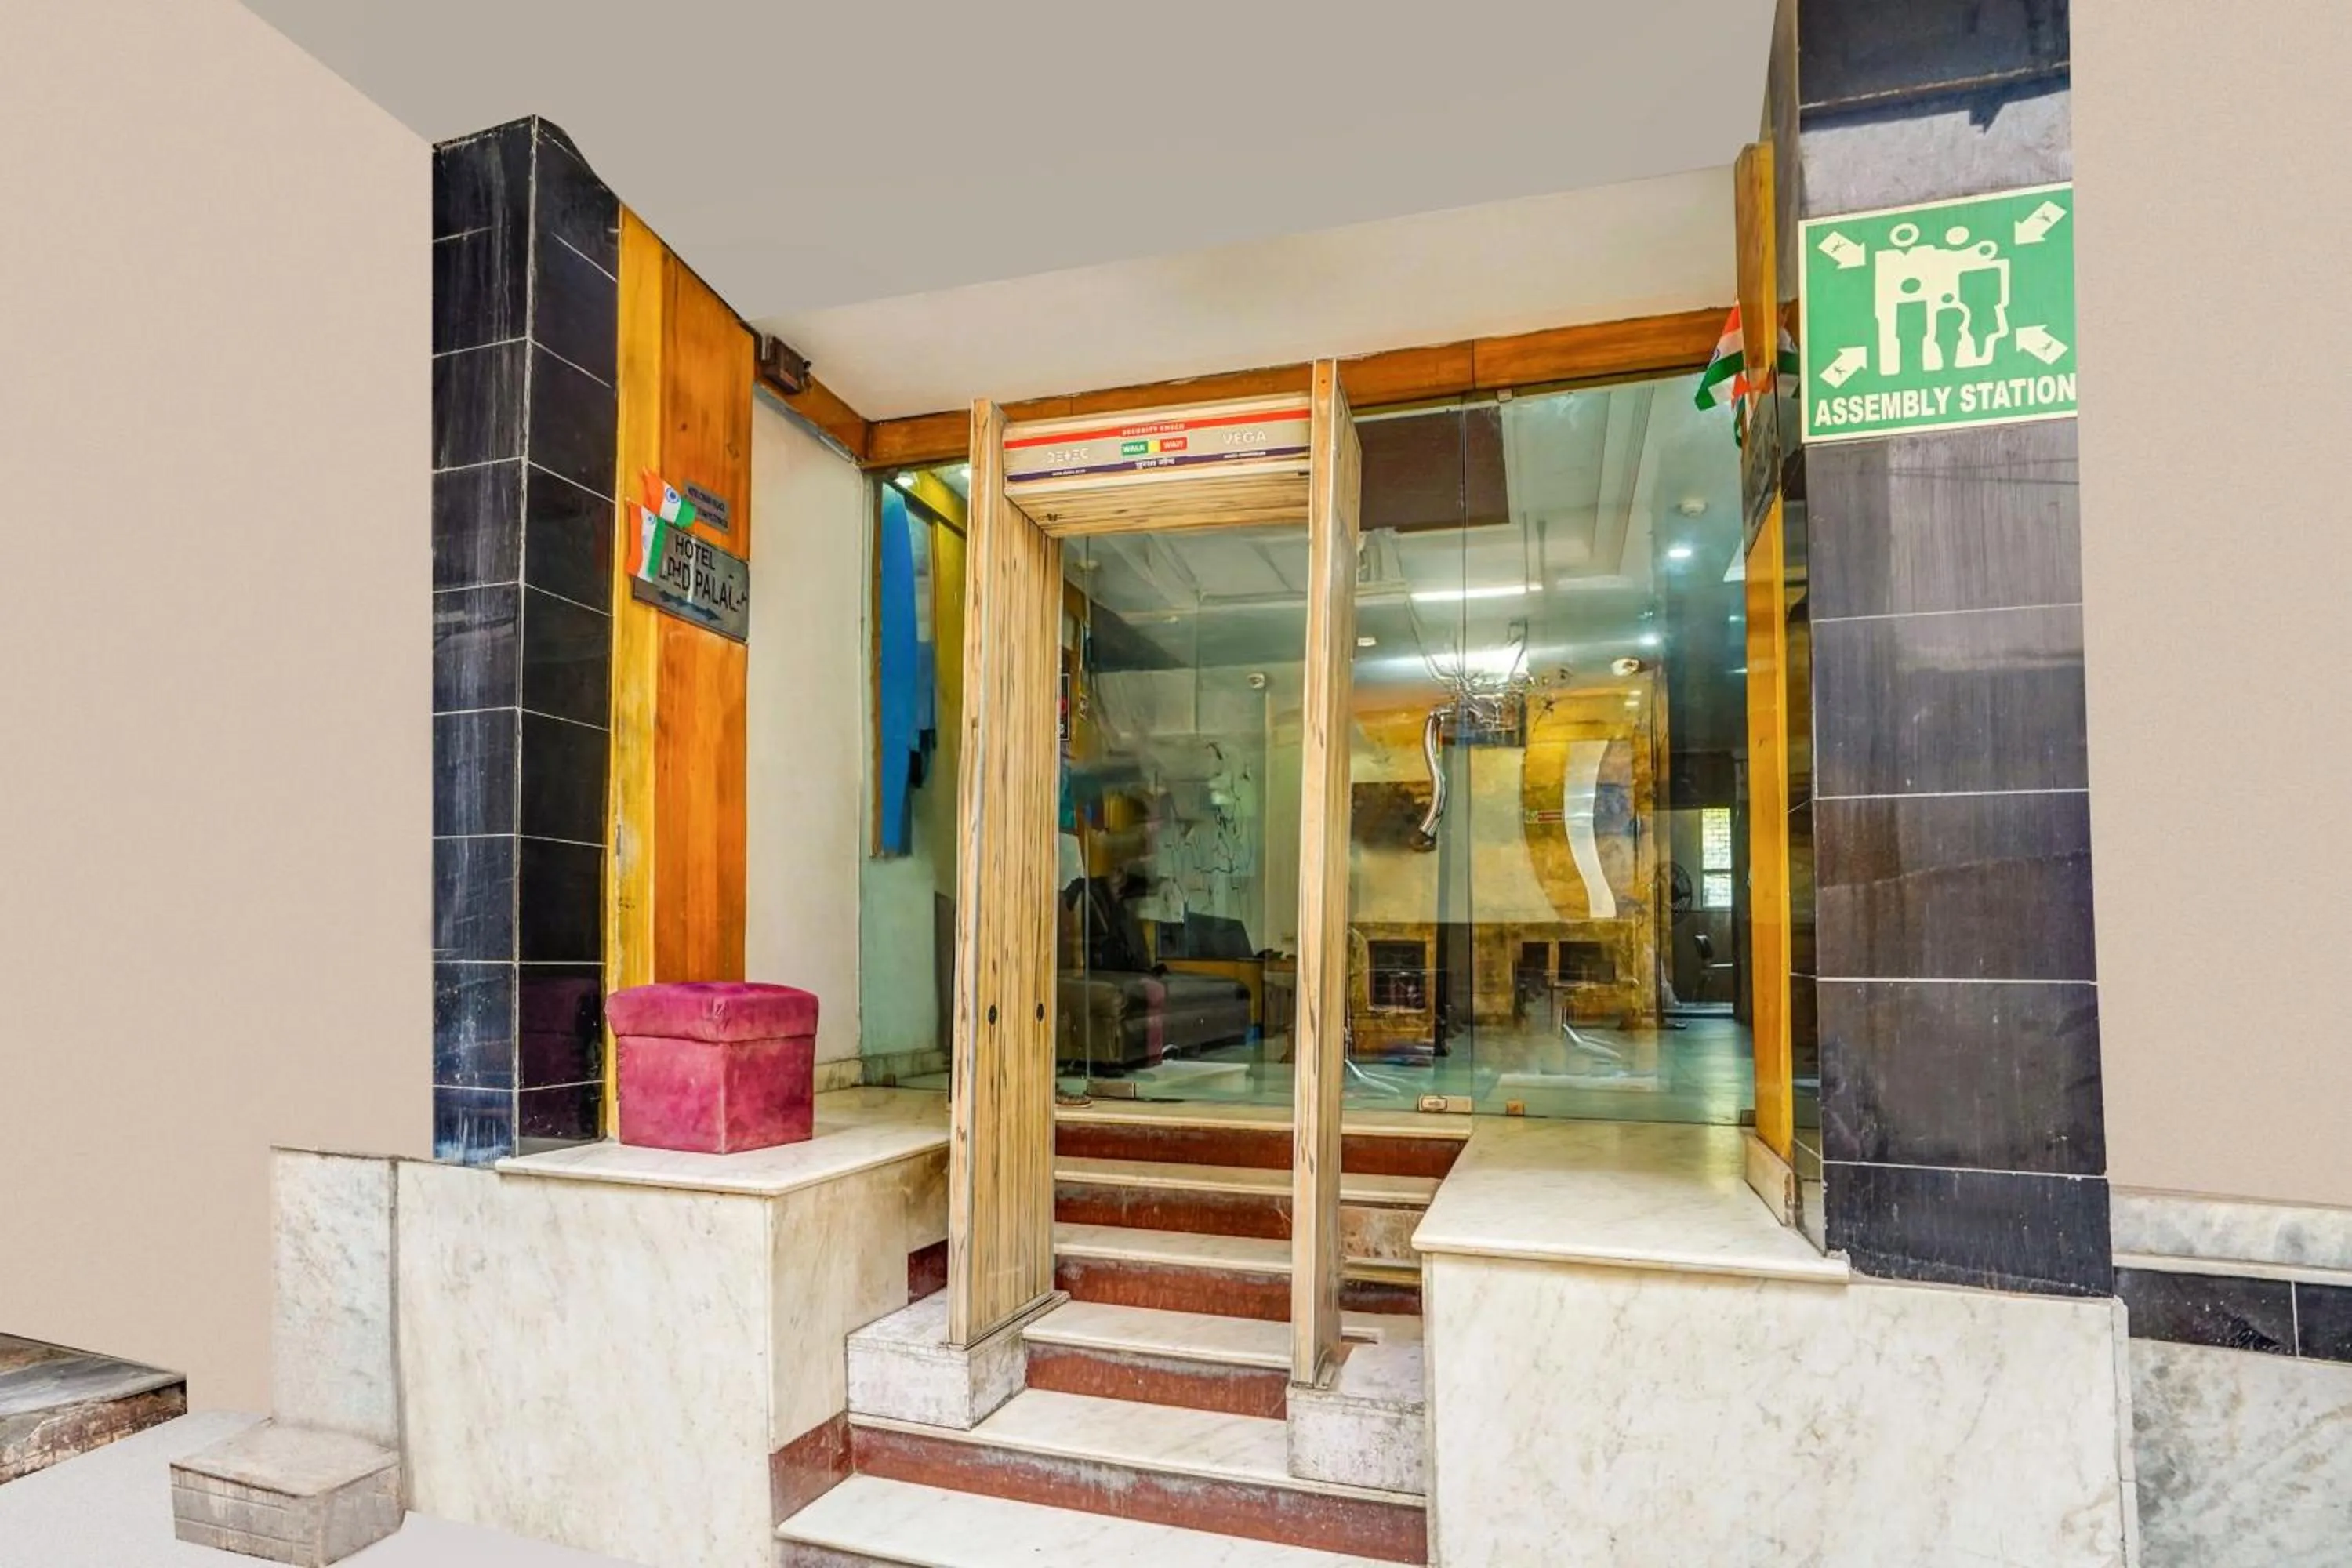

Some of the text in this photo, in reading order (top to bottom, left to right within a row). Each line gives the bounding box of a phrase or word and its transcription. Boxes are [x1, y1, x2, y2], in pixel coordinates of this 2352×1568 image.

[1814, 372, 2077, 427] ASSEMBLY STATION
[1123, 443, 1145, 452] WALK
[1222, 429, 1266, 445] VEGA
[675, 533, 716, 571] HOTEL
